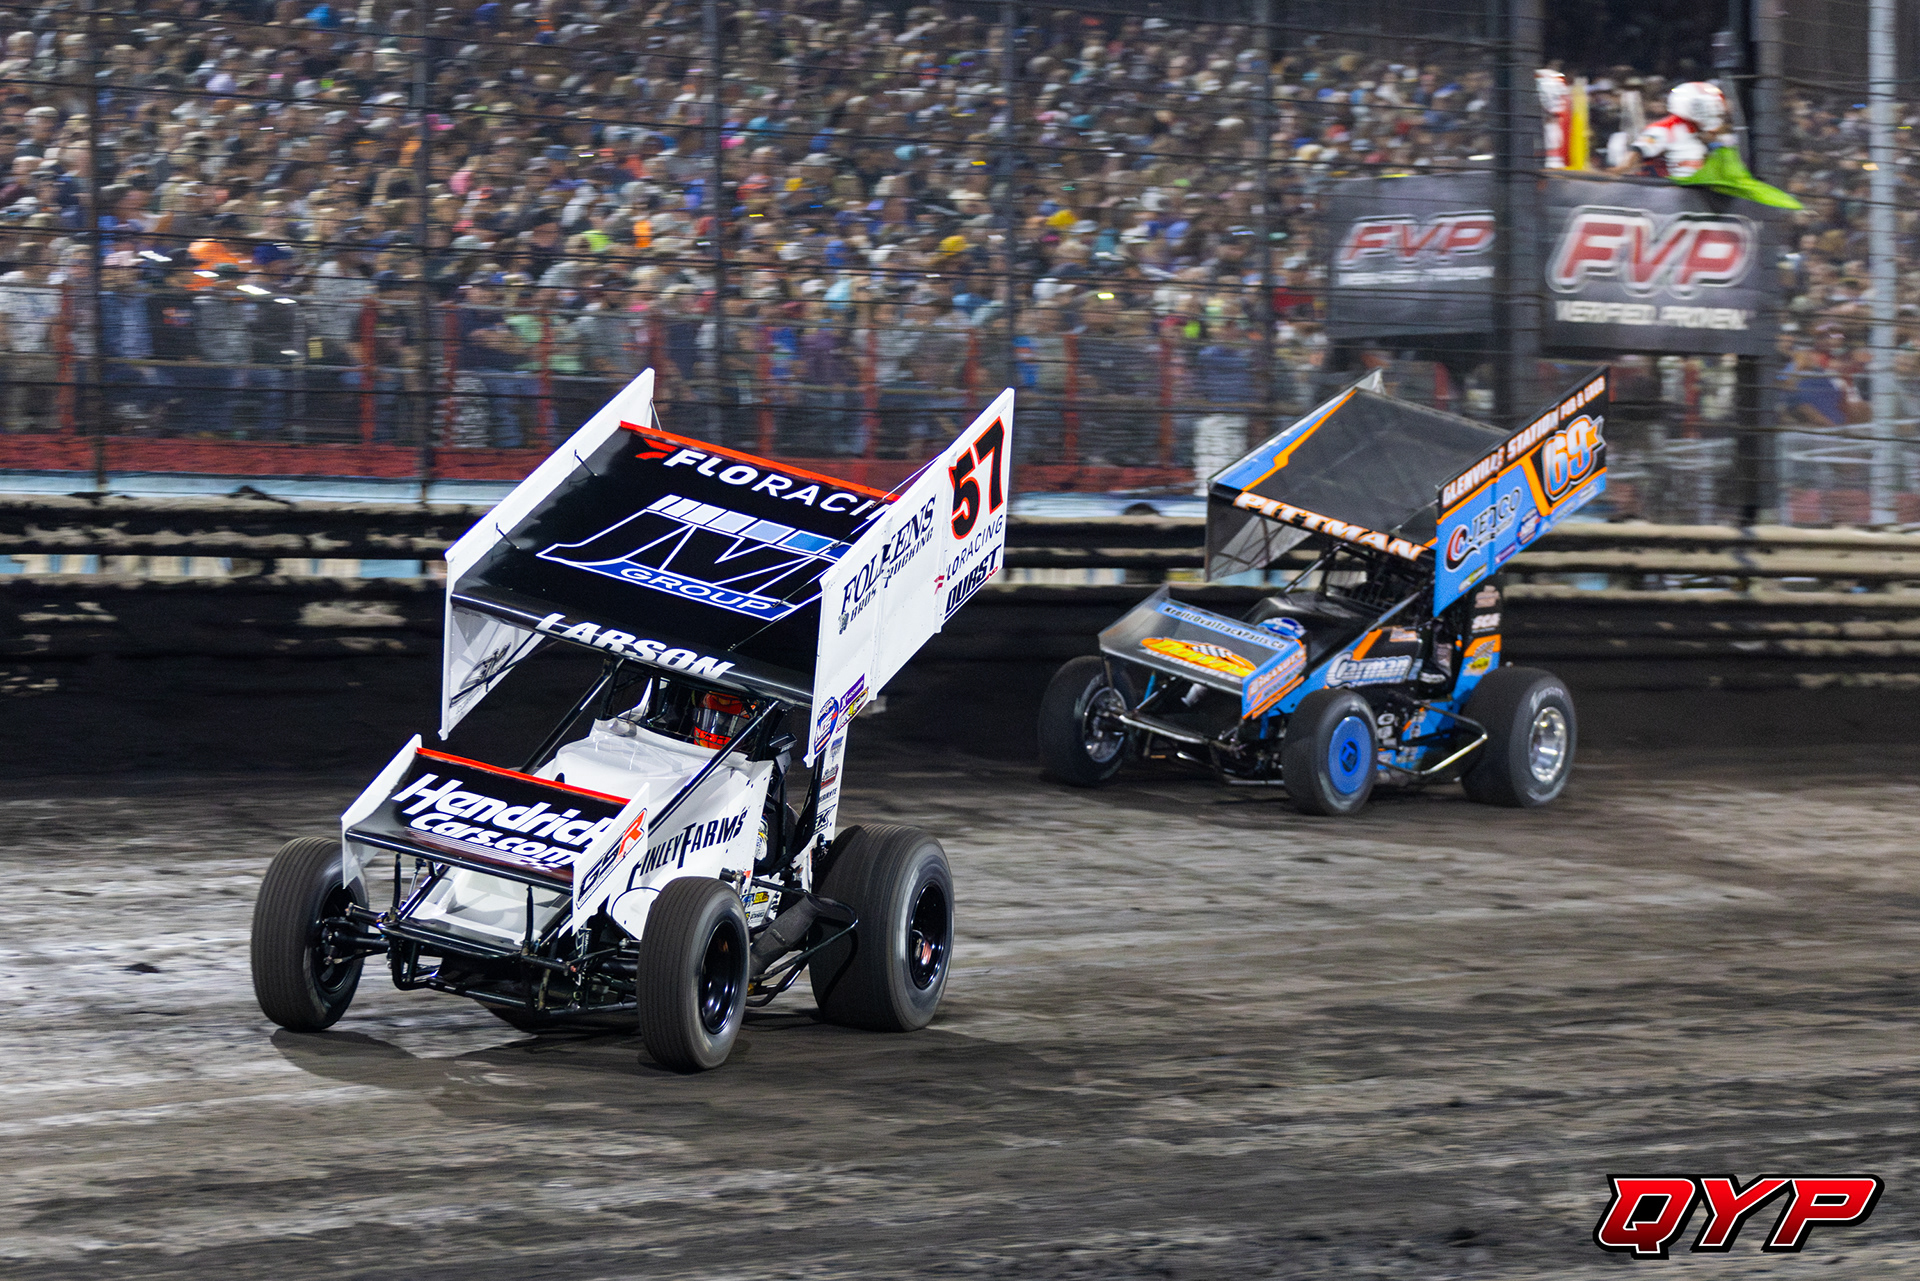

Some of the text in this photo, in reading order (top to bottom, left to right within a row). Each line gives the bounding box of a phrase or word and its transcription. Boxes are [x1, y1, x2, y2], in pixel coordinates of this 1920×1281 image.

[1337, 213, 1495, 267] FVP
[1550, 208, 1754, 295] FVP
[662, 448, 894, 520] FLORACI
[948, 415, 1005, 540] 57
[945, 514, 1004, 581] LORACING
[1232, 491, 1429, 561] PITTMAN
[619, 567, 773, 613] GROUP
[945, 543, 1002, 614] DURST
[535, 612, 736, 680] LARSON
[391, 773, 612, 854] Hendrick
[409, 812, 578, 866] Cars.com
[677, 807, 748, 869] FARMS
[577, 810, 645, 902] GSR
